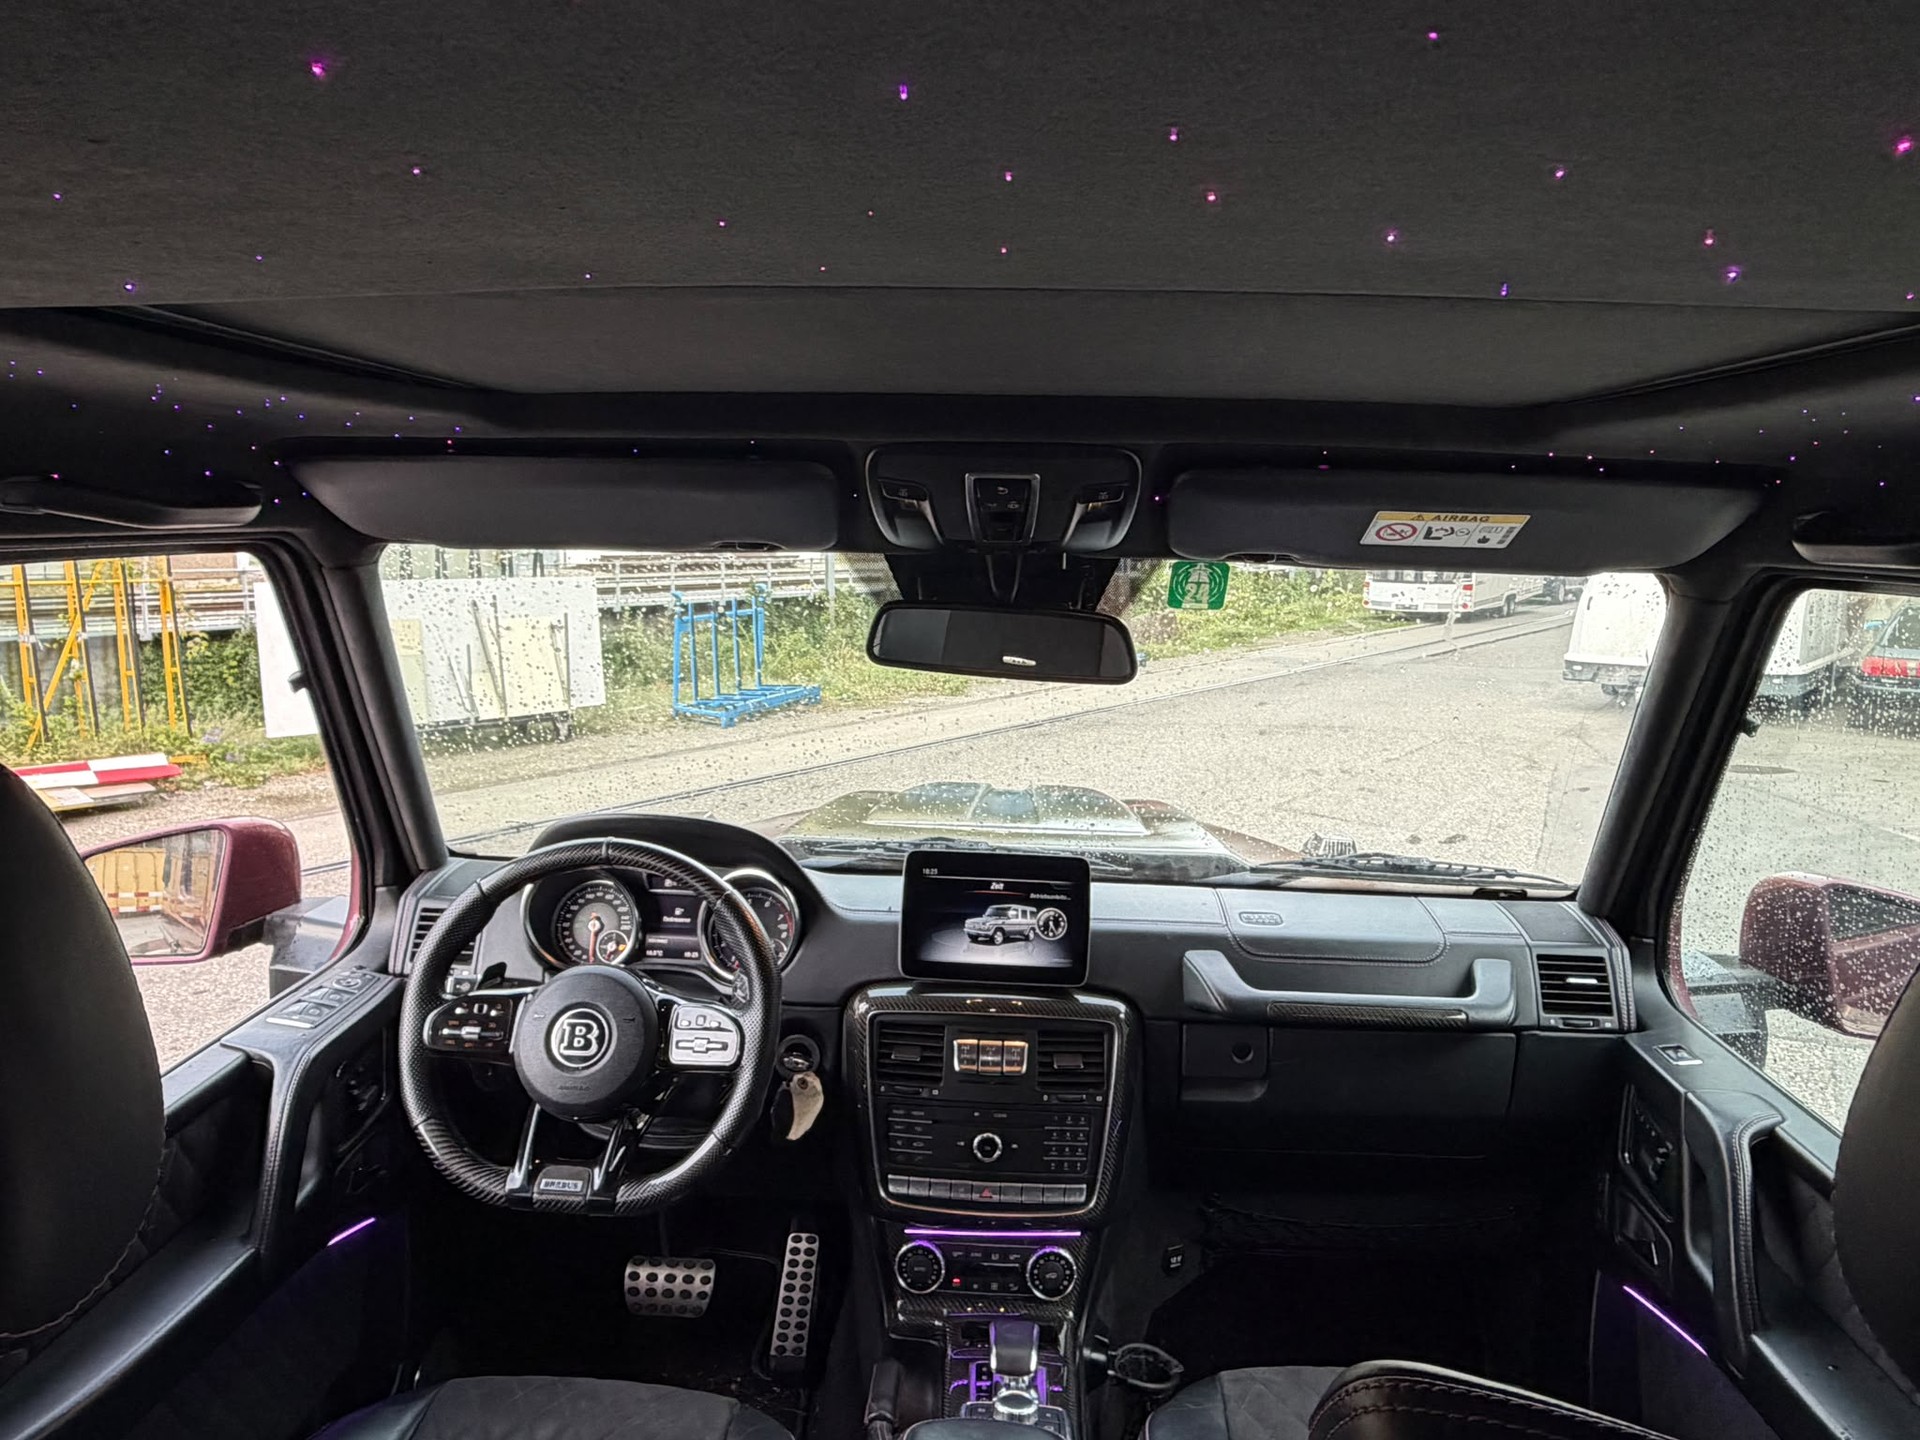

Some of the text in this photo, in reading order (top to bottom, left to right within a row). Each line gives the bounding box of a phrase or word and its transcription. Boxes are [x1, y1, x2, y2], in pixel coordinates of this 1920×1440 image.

[1431, 514, 1490, 523] AIRBAG
[1184, 583, 1210, 604] 24
[560, 1018, 600, 1056] B
